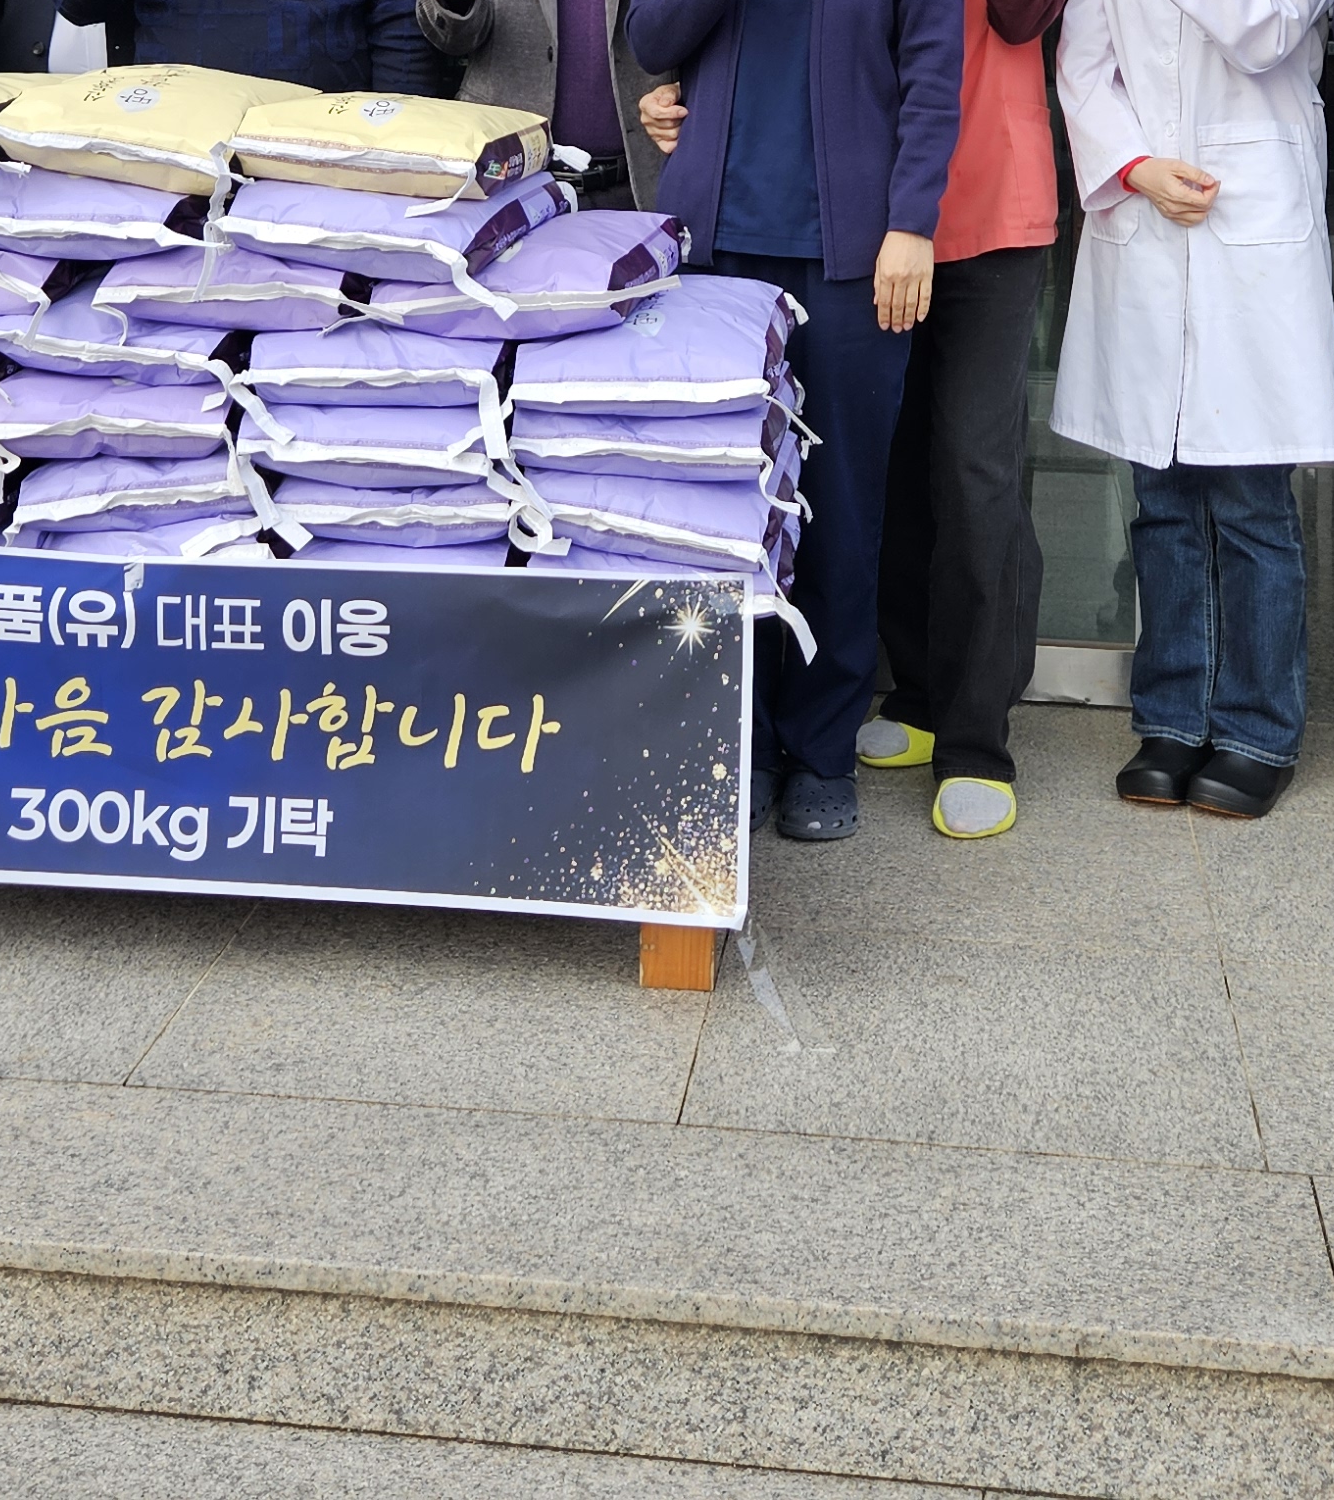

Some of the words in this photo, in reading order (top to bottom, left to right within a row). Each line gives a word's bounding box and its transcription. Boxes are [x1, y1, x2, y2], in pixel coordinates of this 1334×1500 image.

[156, 593, 265, 652] 대표
[282, 598, 391, 656] 이웅
[141, 678, 562, 773] 감사합니다
[7, 785, 210, 862] 300kg
[226, 795, 334, 857] 기탁
